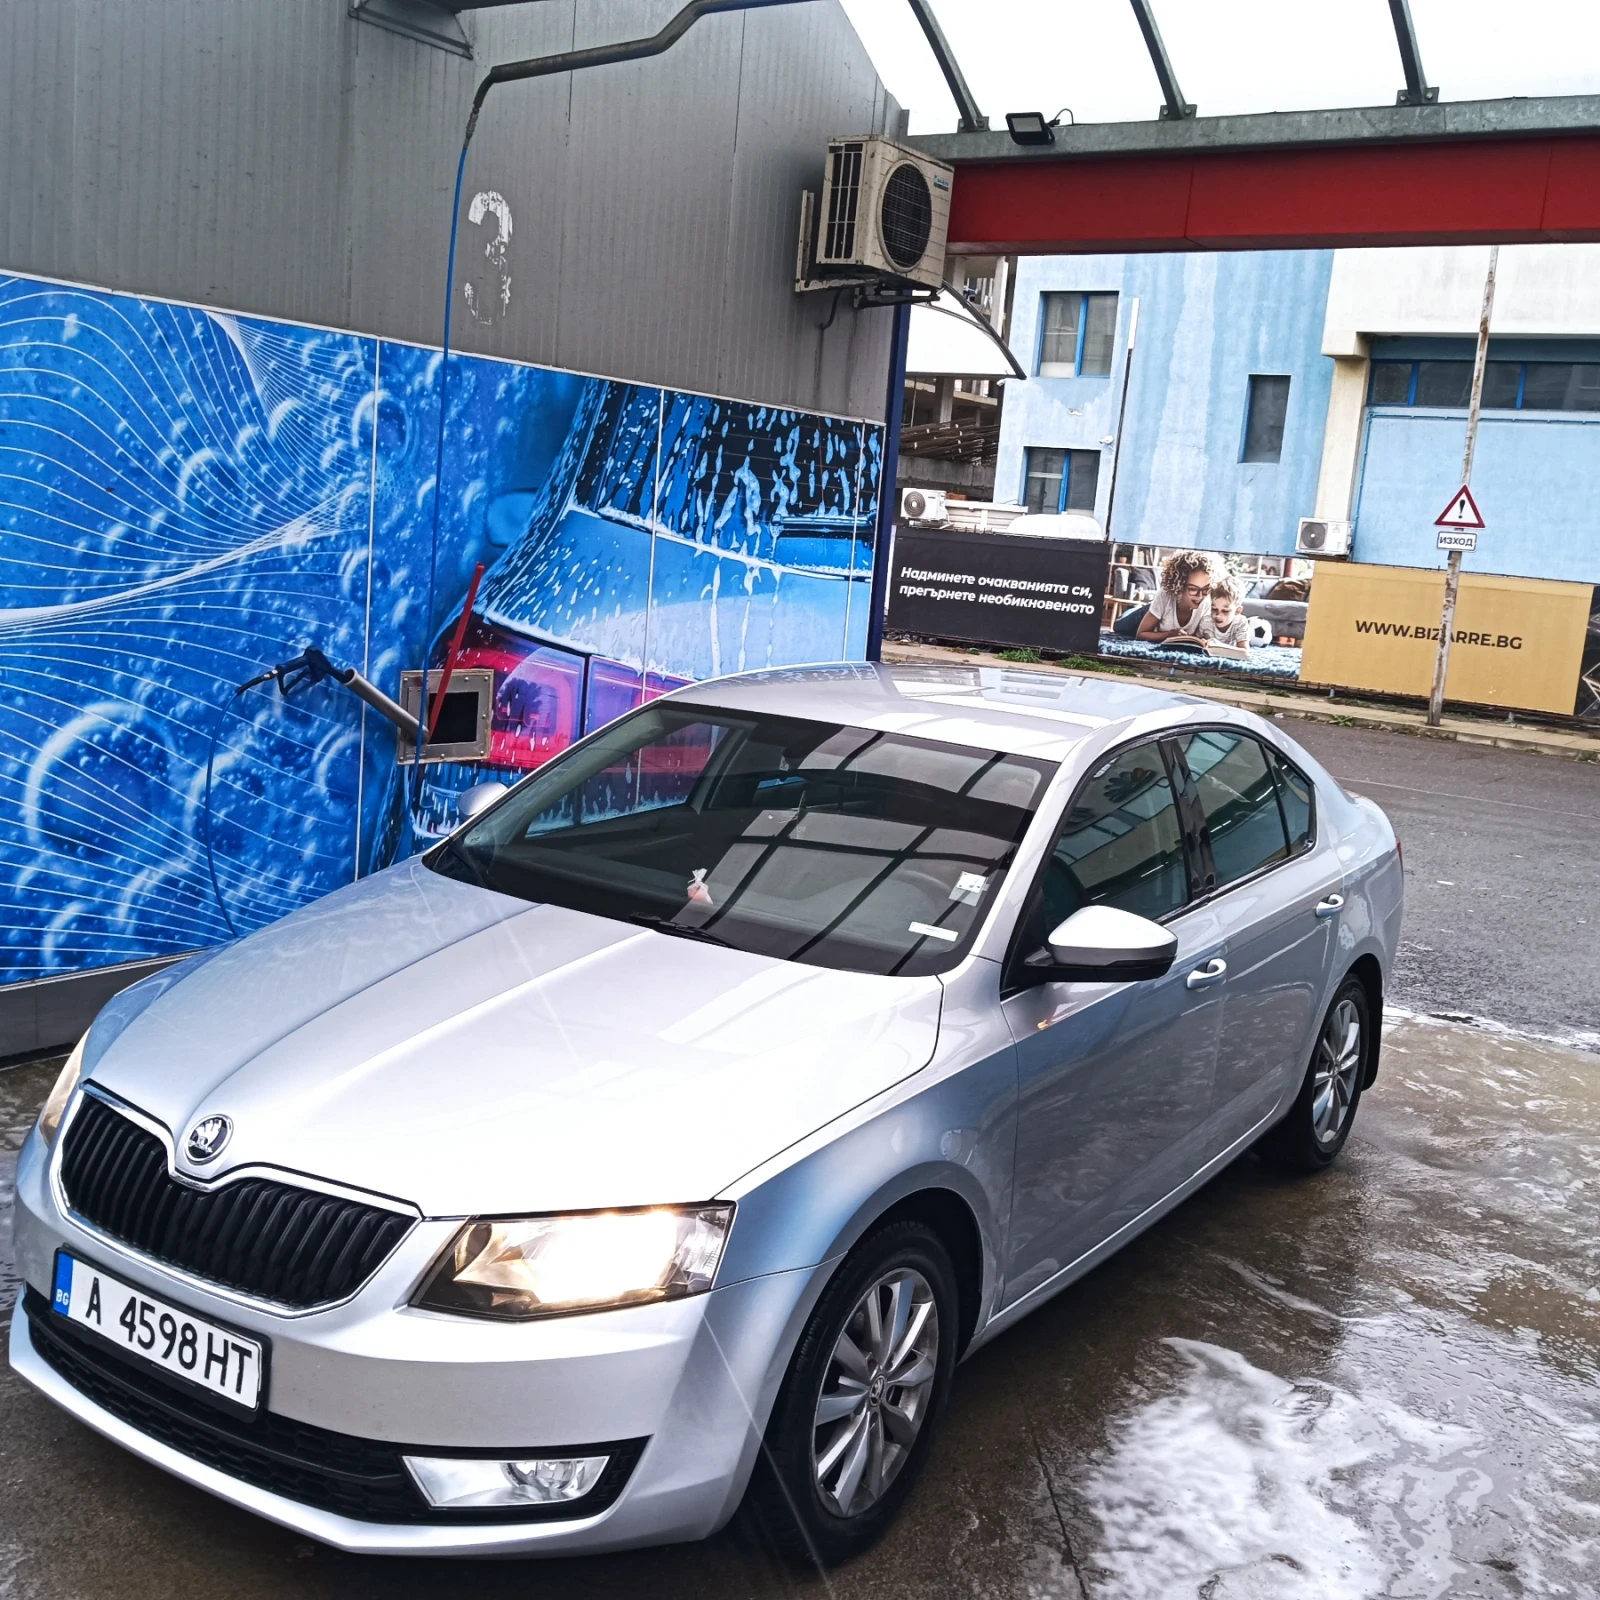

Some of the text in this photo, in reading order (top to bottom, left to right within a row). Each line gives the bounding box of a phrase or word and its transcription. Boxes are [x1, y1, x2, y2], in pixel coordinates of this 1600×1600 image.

[464, 190, 513, 326] 3
[1439, 536, 1473, 547] ИЗХОД
[900, 566, 1093, 599] Надминете очакванията си,
[899, 584, 1095, 615] прегърнете необикновеното
[56, 1288, 70, 1306] BG
[85, 1276, 102, 1326] A
